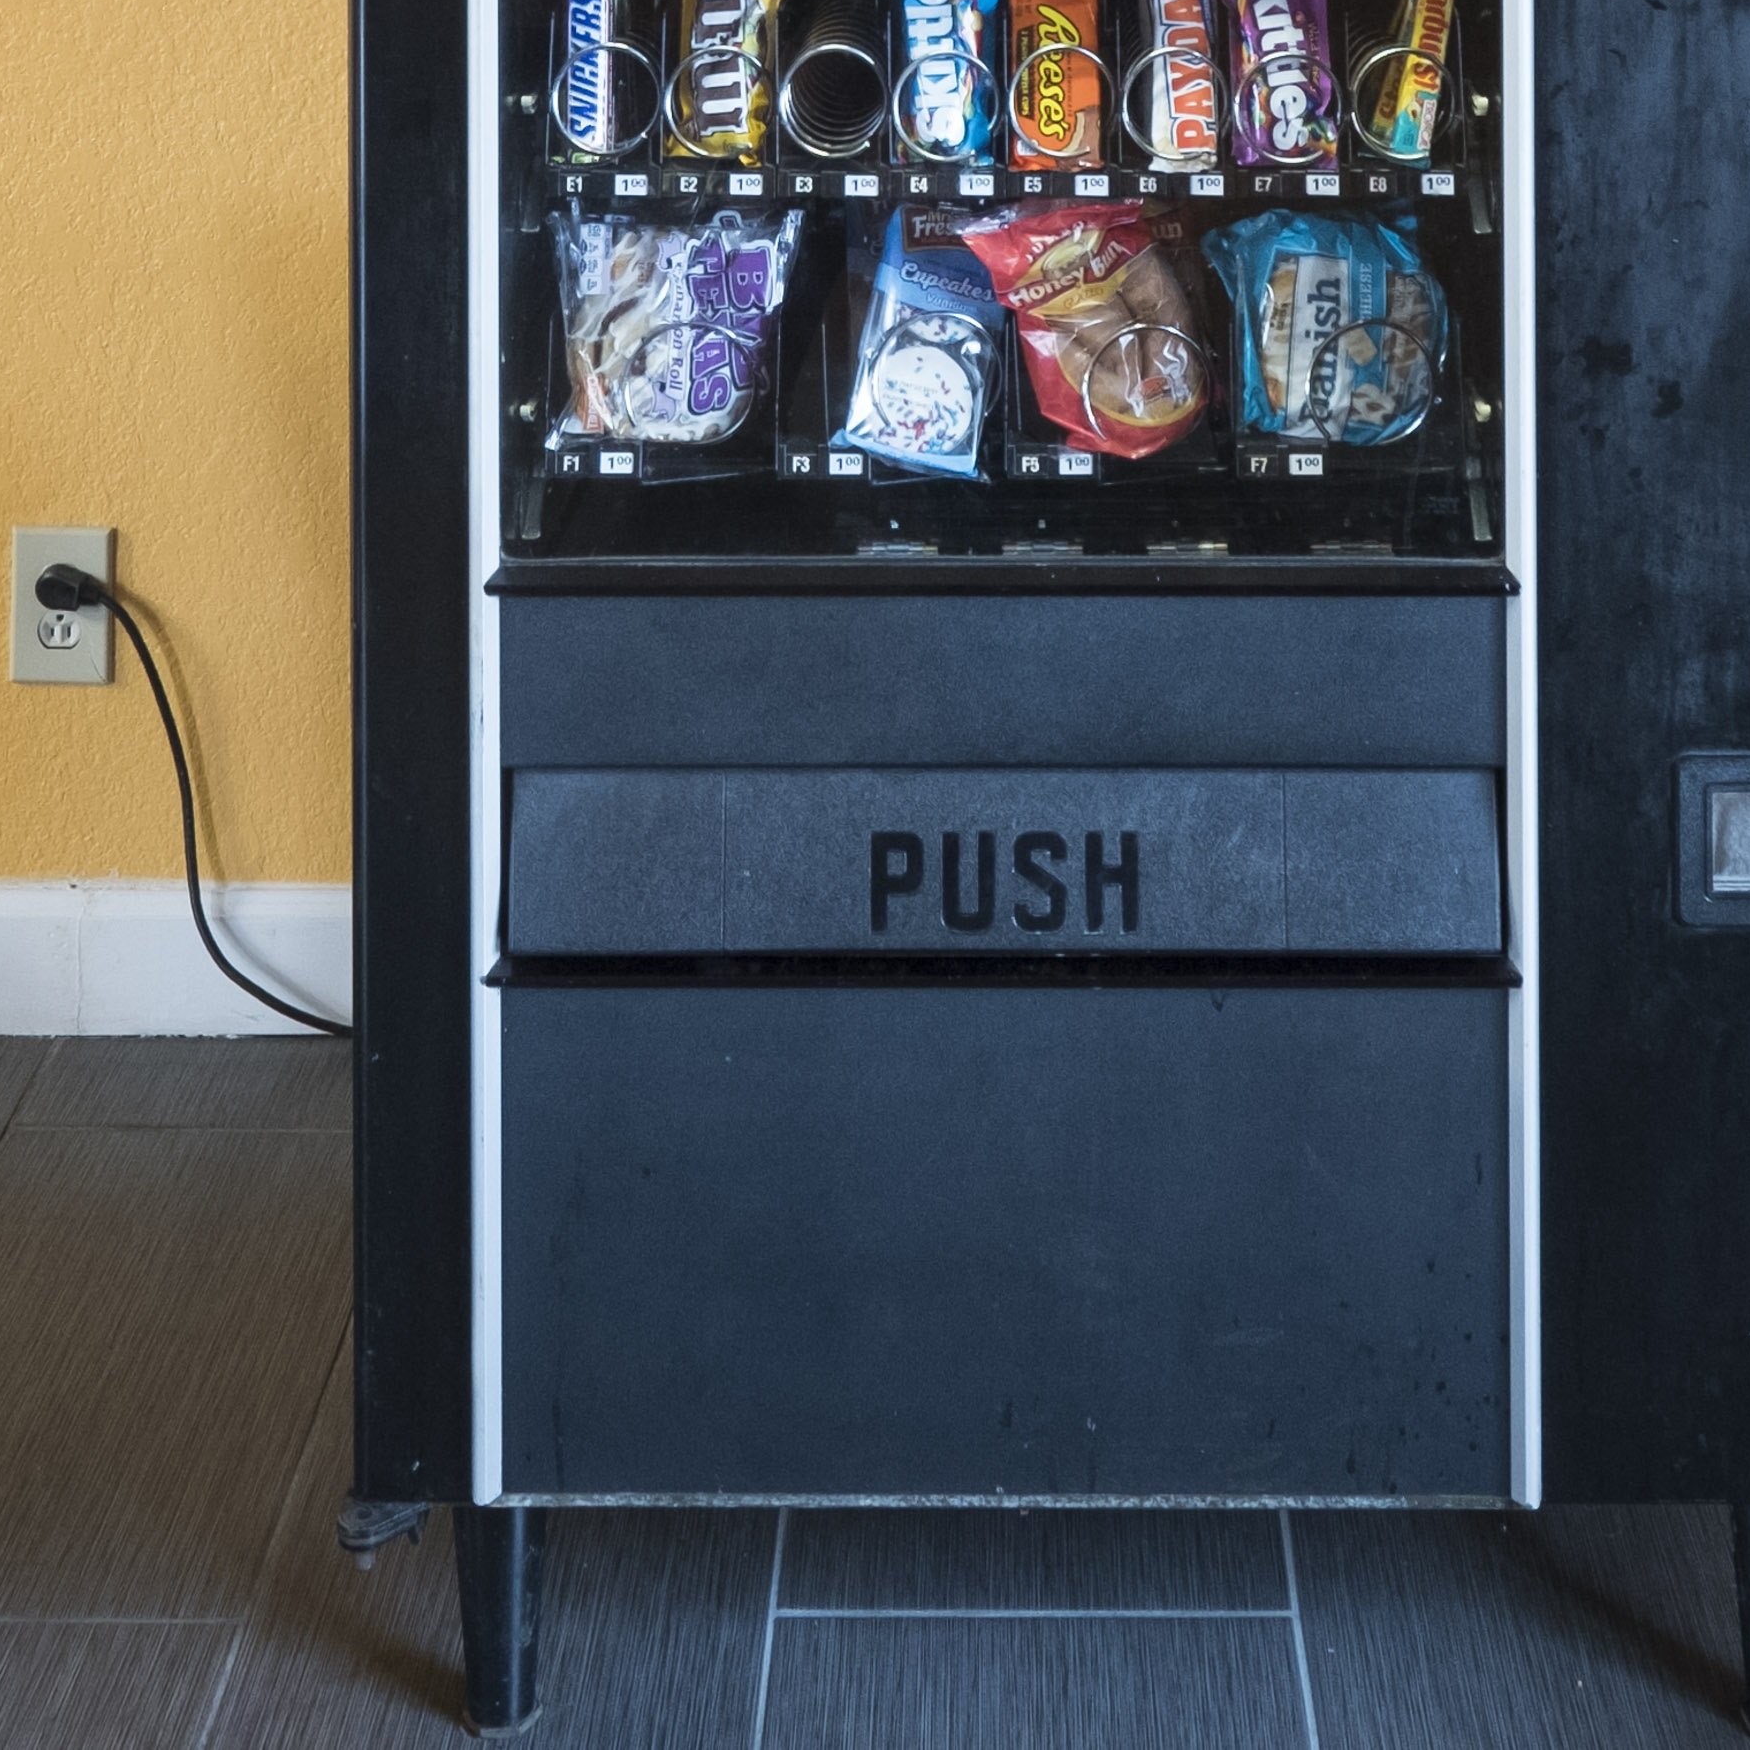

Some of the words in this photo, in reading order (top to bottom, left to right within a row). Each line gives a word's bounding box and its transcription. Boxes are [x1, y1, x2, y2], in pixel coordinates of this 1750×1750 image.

[1037, 4, 1082, 141] Reese's
[566, 176, 582, 193] E1
[680, 176, 698, 193] E2
[795, 176, 812, 193] E3
[910, 176, 928, 193] E4
[1024, 176, 1042, 193] E5
[1139, 176, 1157, 193] E6
[1255, 176, 1272, 193] E7
[1369, 176, 1388, 193] E8
[1088, 240, 1135, 279] Bun
[899, 260, 995, 302] Cupcakes
[1006, 266, 1086, 308] Honey
[687, 229, 730, 417] TEXAS
[1298, 278, 1342, 423] Danish
[669, 356, 685, 391] Roll
[563, 454, 580, 472] F1
[792, 456, 810, 472] F3
[1022, 456, 1040, 473] F5
[1250, 457, 1268, 473] F7
[868, 829, 1143, 936] PUSH
